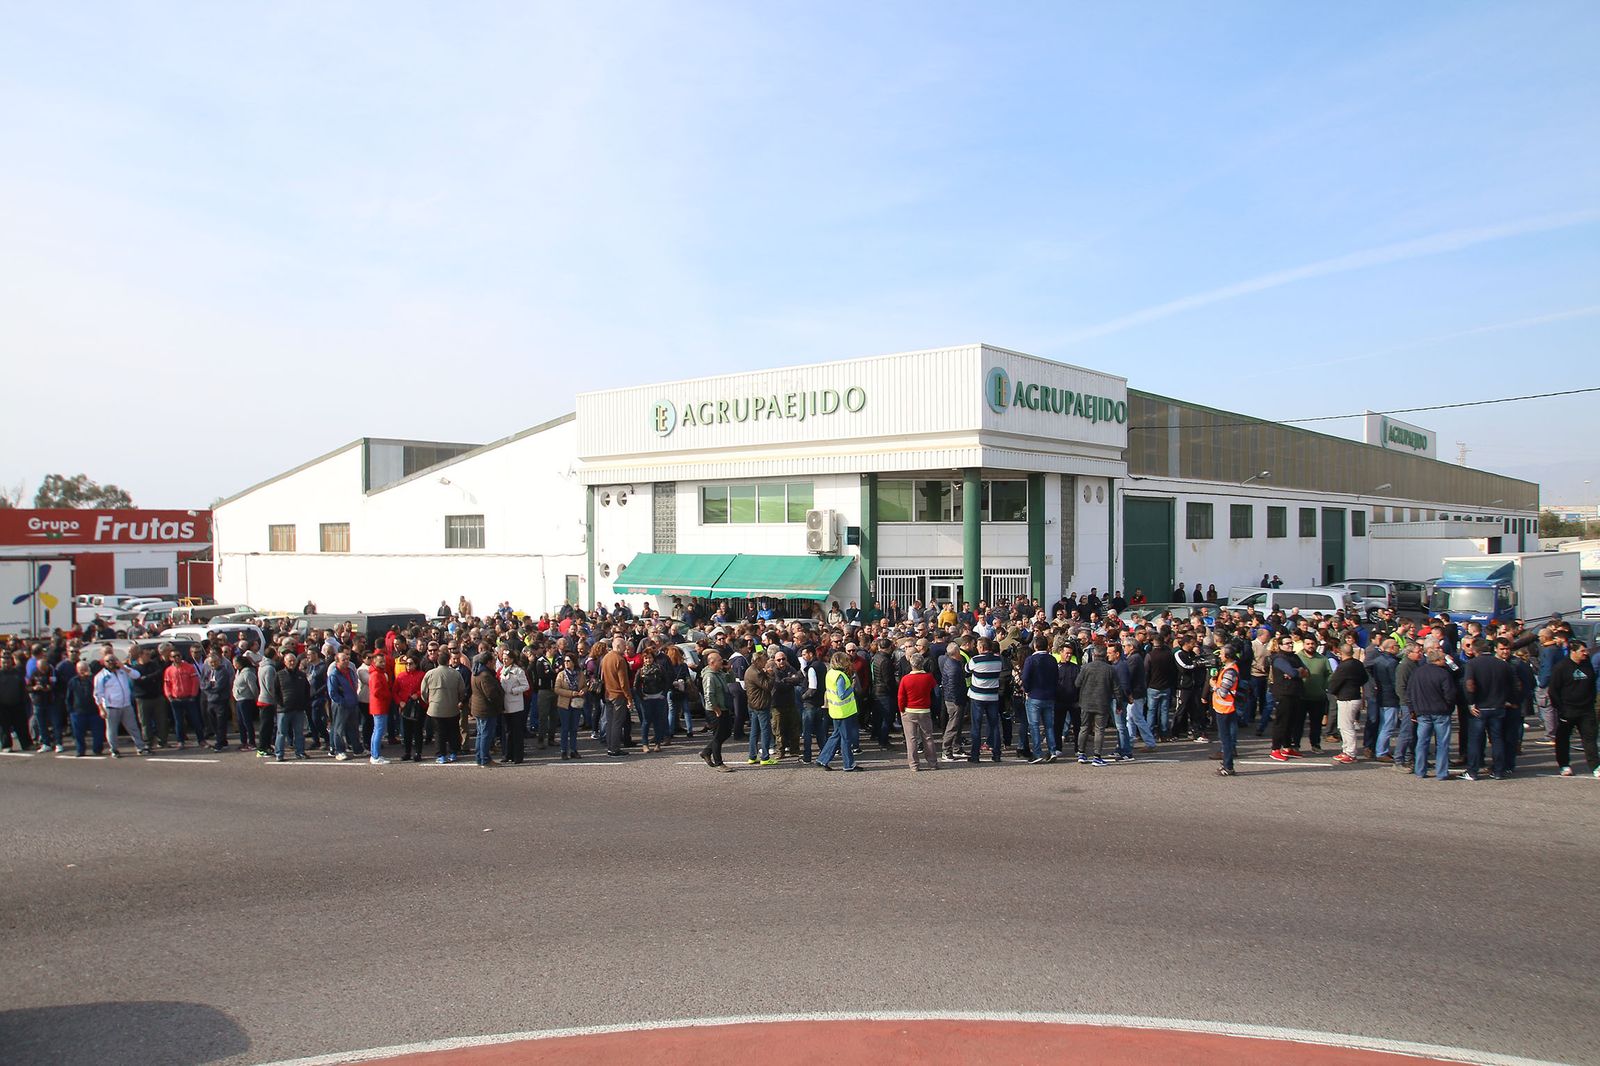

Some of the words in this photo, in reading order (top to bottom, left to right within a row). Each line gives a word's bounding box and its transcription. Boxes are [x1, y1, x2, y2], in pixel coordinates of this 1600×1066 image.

[682, 386, 866, 426] AGRUPAEJIDO
[1013, 381, 1127, 424] AGRUPAEJIDO
[28, 517, 80, 533] Grupo
[94, 515, 195, 541] Frutas
